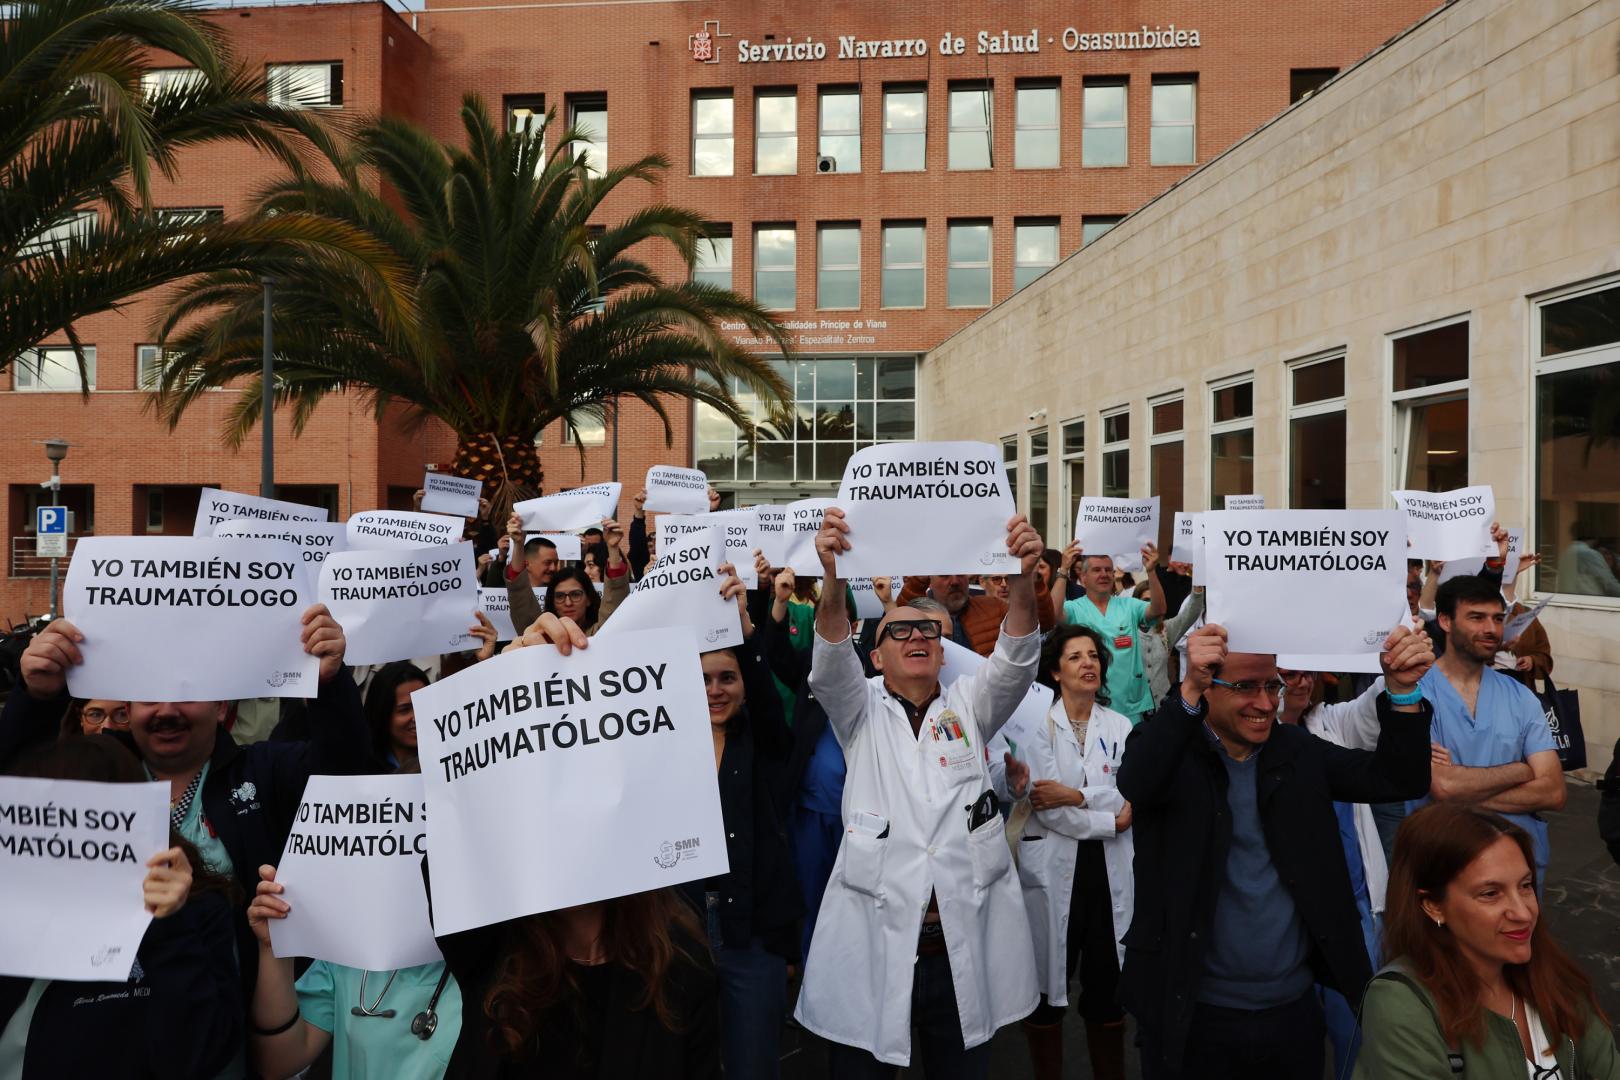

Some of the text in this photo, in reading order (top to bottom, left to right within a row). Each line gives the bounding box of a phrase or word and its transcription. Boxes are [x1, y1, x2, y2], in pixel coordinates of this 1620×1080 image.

[738, 37, 827, 63] Servicio
[838, 35, 928, 59] Navarro
[939, 32, 965, 56] de
[977, 29, 1040, 54] Salud
[1062, 24, 1201, 51] Osasunbidea
[720, 320, 746, 331] Centro
[853, 319, 863, 329] de
[866, 319, 887, 329] Viana
[852, 457, 996, 480] YO TAMBIÉN SOY
[850, 480, 1001, 501] TRAUMATÓLOGA
[211, 500, 230, 513] YO
[232, 505, 290, 522] TAMBIÉN
[1135, 505, 1153, 513] SOY
[1404, 498, 1417, 507] YO
[1460, 496, 1482, 506] SOY
[41, 509, 57, 532] P
[359, 516, 452, 534] YO TAMBIÉN SOY
[759, 513, 771, 521] YO
[793, 510, 808, 519] YO
[1083, 514, 1152, 523] TRAUMATÓLOGA
[305, 535, 334, 547] SOY
[356, 525, 449, 545] TRAUMATÓLOGA
[664, 525, 678, 534] YO
[727, 527, 748, 536] SOY
[1223, 530, 1253, 547] YO
[1257, 526, 1345, 547] TAMBIÉN
[1350, 530, 1389, 547] SOY
[679, 545, 711, 563] SOY
[1224, 550, 1387, 571] TRAUMATÓLOGA
[91, 556, 295, 580] YO TAMBIÉN SOY
[333, 558, 462, 581] YO TAMBIÉN SOY
[85, 584, 298, 607] TRAUMATÓLOGO
[331, 577, 462, 601] TRAUMATÓLOGO
[433, 663, 667, 742] YO TAMBIÉN SOY
[440, 705, 675, 783] TRAUMATÓLOGA
[0, 801, 137, 832] MBIÉN SOY
[313, 797, 413, 824] TAMBIÉN
[0, 833, 138, 864] MATÓLOGA
[288, 829, 427, 857] TRAUMATÓLO
[675, 837, 700, 851] SMN
